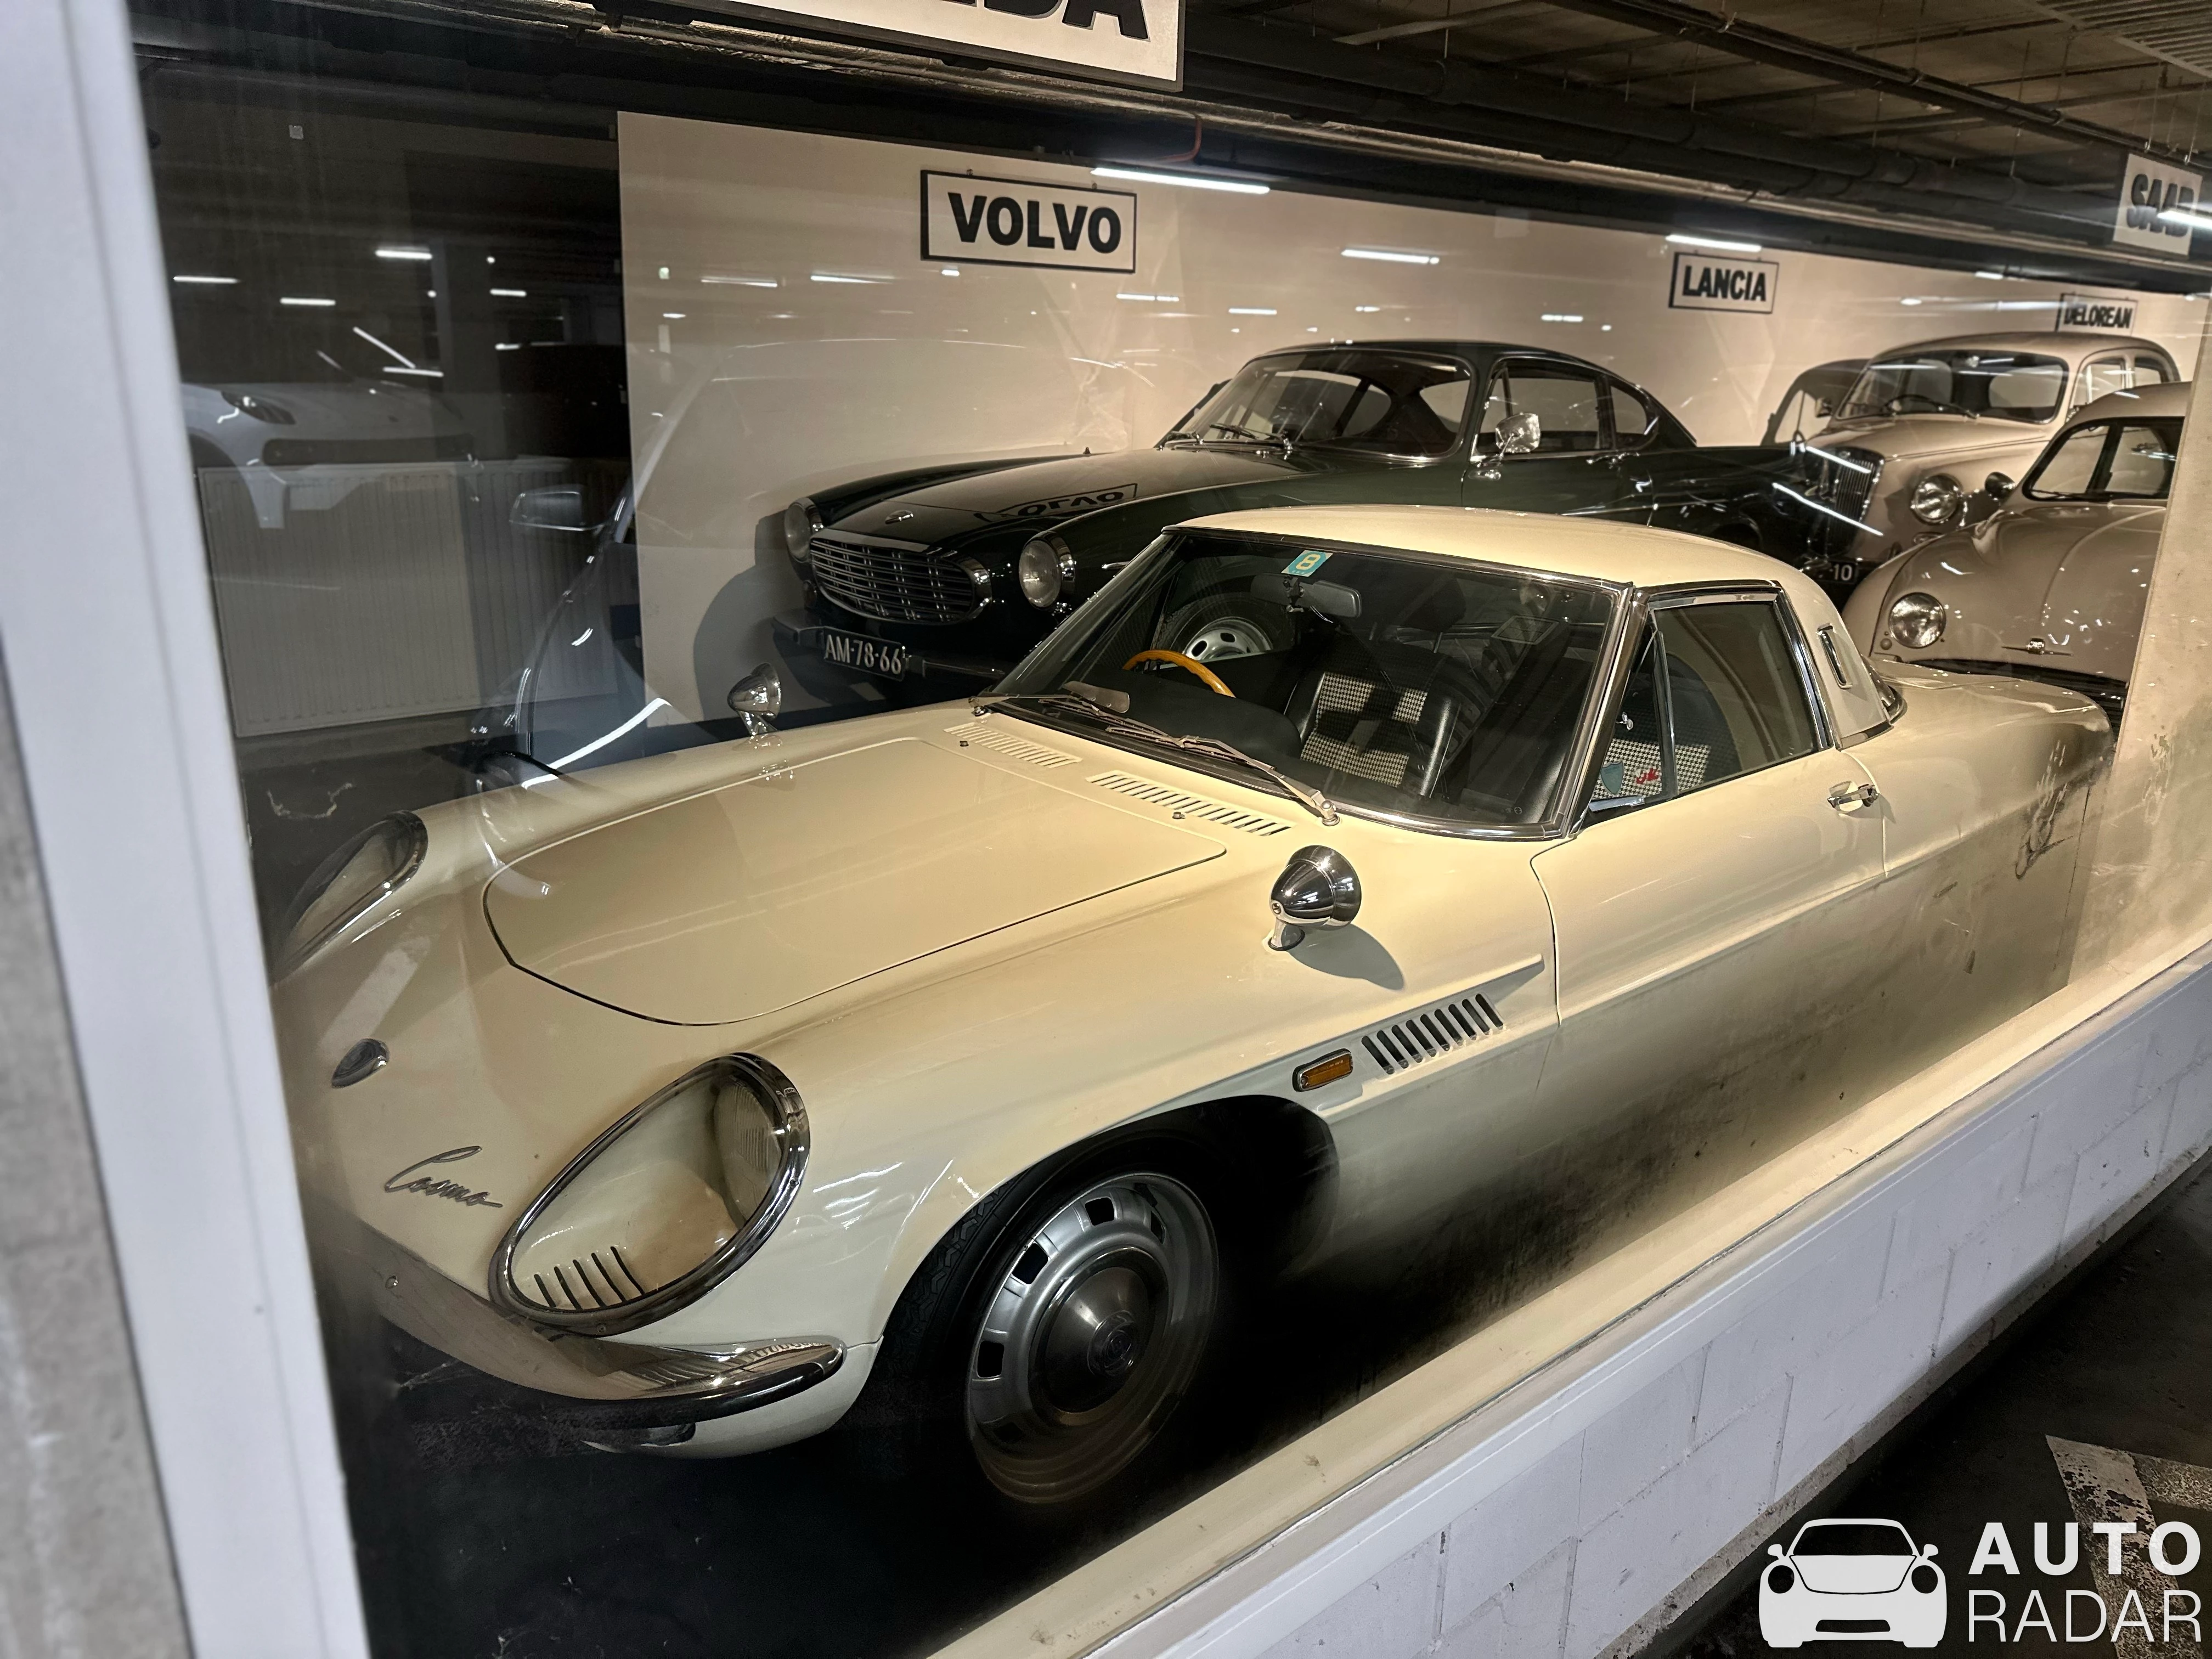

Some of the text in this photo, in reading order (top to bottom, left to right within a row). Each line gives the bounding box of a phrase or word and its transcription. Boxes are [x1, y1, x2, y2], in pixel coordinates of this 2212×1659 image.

[947, 192, 1121, 254] VOLVO
[1683, 265, 1766, 301] LANCIA
[2064, 304, 2133, 329] DELOREAN
[1296, 554, 1321, 570] 8
[825, 634, 901, 674] AM-78-66
[384, 1145, 503, 1207] Cosmo
